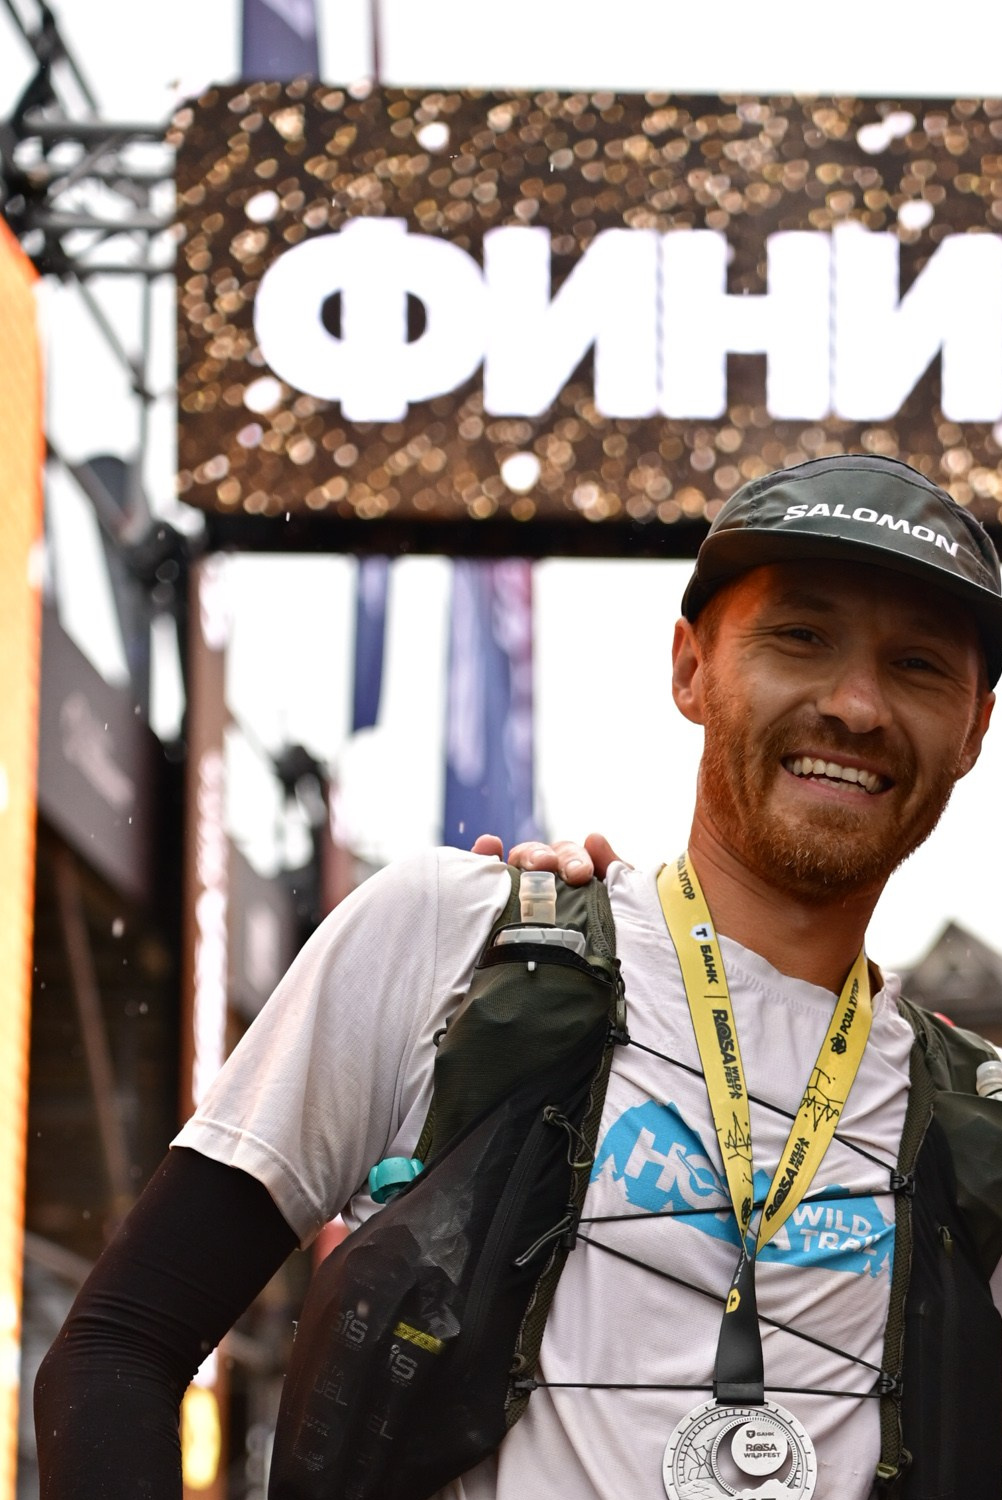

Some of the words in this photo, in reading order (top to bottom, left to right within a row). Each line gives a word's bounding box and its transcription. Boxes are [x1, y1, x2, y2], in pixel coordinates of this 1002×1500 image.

[782, 503, 959, 557] SALOMON
[678, 869, 696, 901] ХУТОР
[700, 944, 719, 985] БАНК
[840, 1004, 856, 1036] РОЗА
[712, 1008, 737, 1065] ROSA
[724, 1065, 737, 1092] FEST
[731, 1066, 742, 1091] WILD
[788, 1145, 802, 1165] WILD
[794, 1149, 807, 1170] FEST
[764, 1168, 798, 1221] ROSA
[792, 1205, 872, 1237] WILD
[746, 1443, 778, 1452] ROSA
